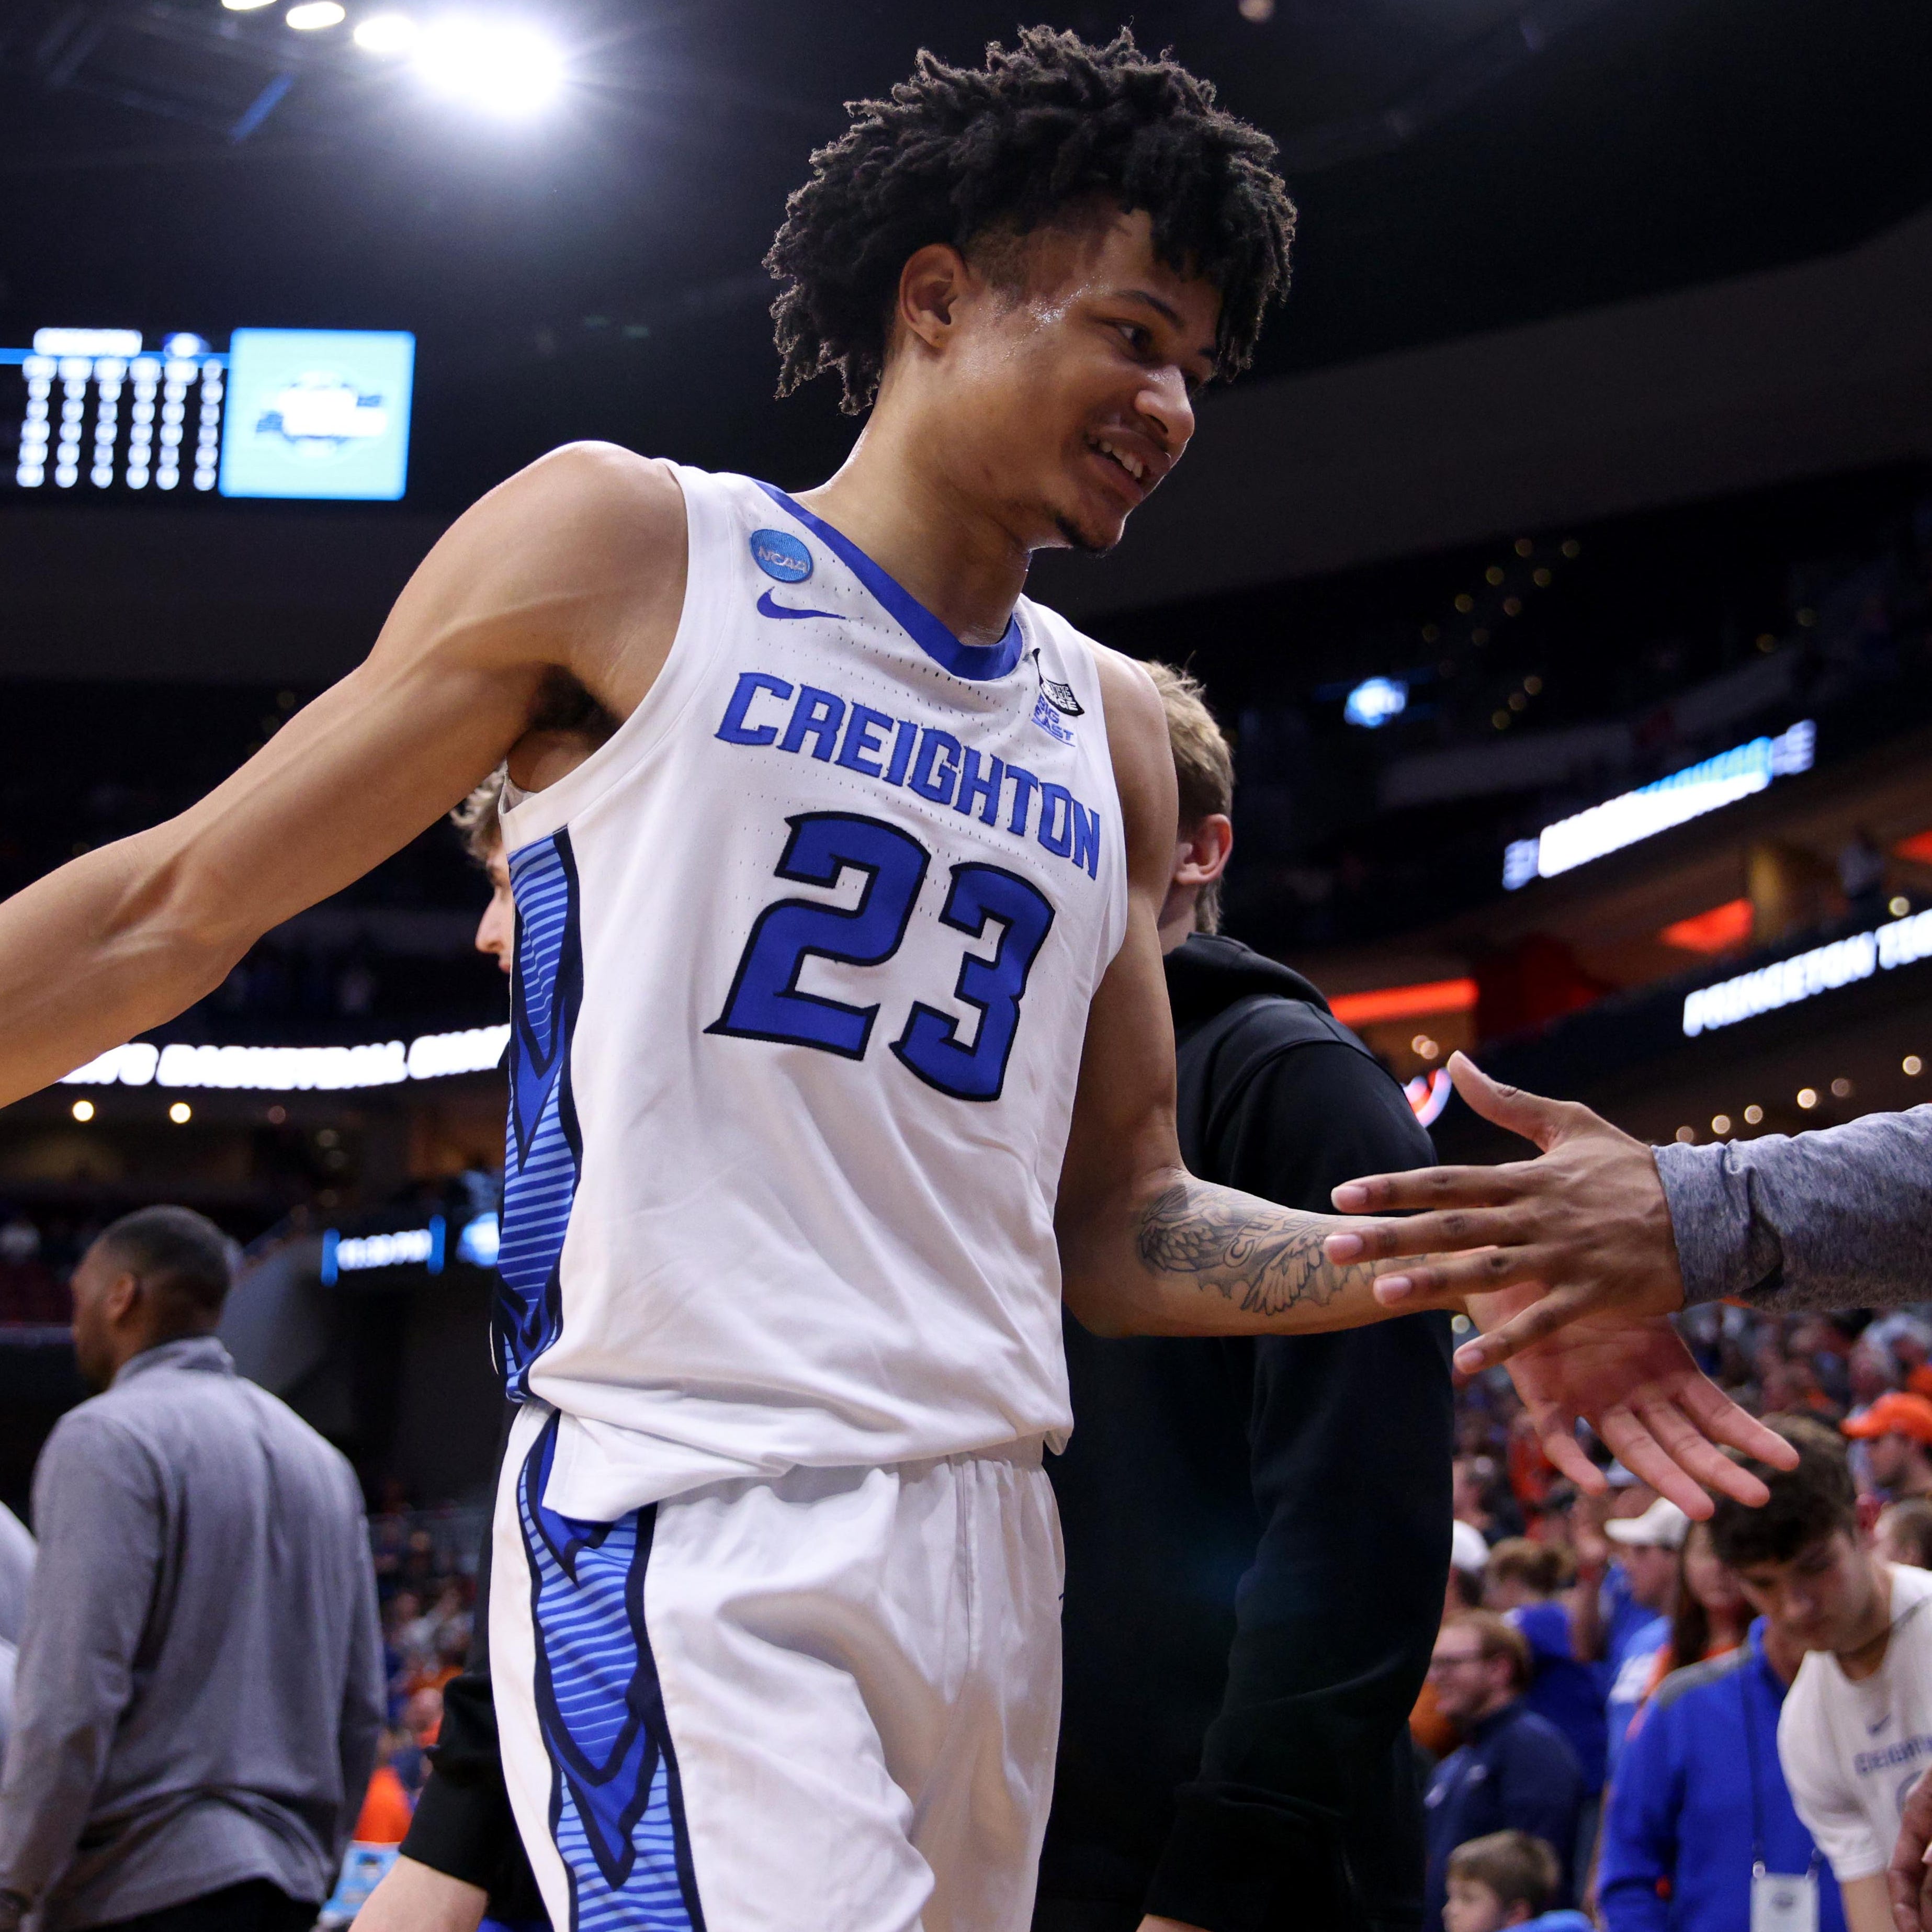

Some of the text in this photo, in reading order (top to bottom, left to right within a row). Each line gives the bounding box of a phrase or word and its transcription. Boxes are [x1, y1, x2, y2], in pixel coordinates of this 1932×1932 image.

[759, 545, 808, 573] NCAA
[1033, 704, 1075, 741] EAST
[1037, 693, 1060, 724] BIG
[714, 672, 1100, 881] CREIGHTON
[703, 810, 1056, 1102] 23
